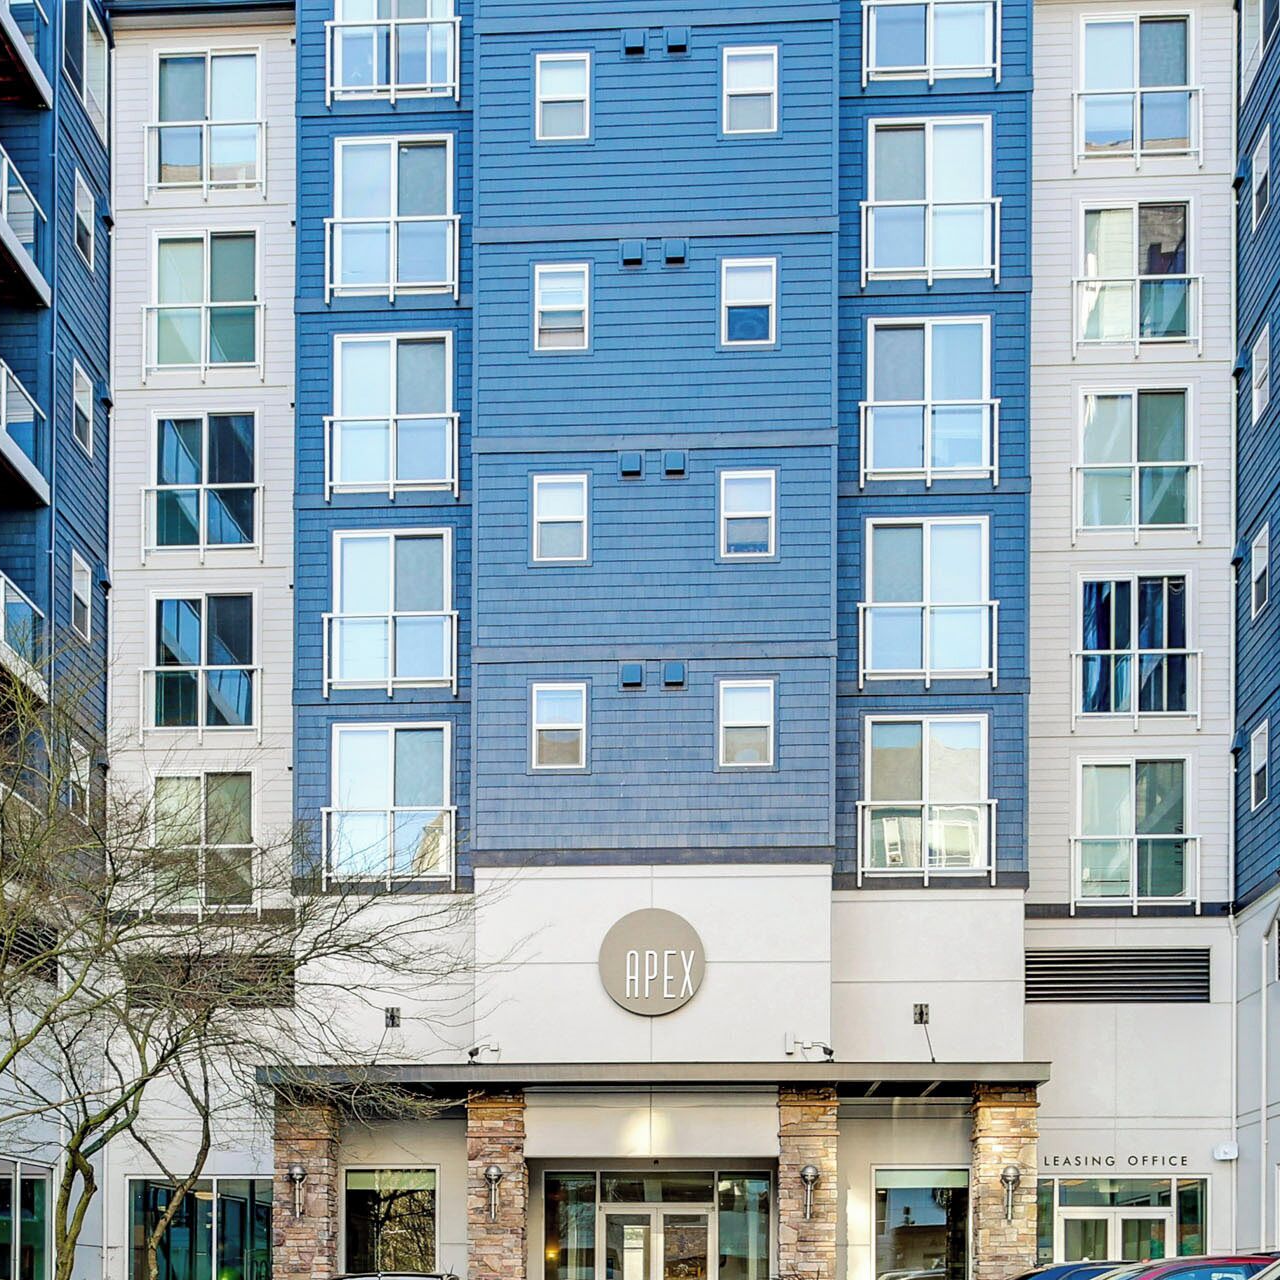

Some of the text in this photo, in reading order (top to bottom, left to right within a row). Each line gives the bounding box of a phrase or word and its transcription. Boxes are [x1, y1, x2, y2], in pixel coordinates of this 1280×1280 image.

[625, 950, 695, 998] APEX
[1044, 1155, 1188, 1166] LEASING OFFICE
